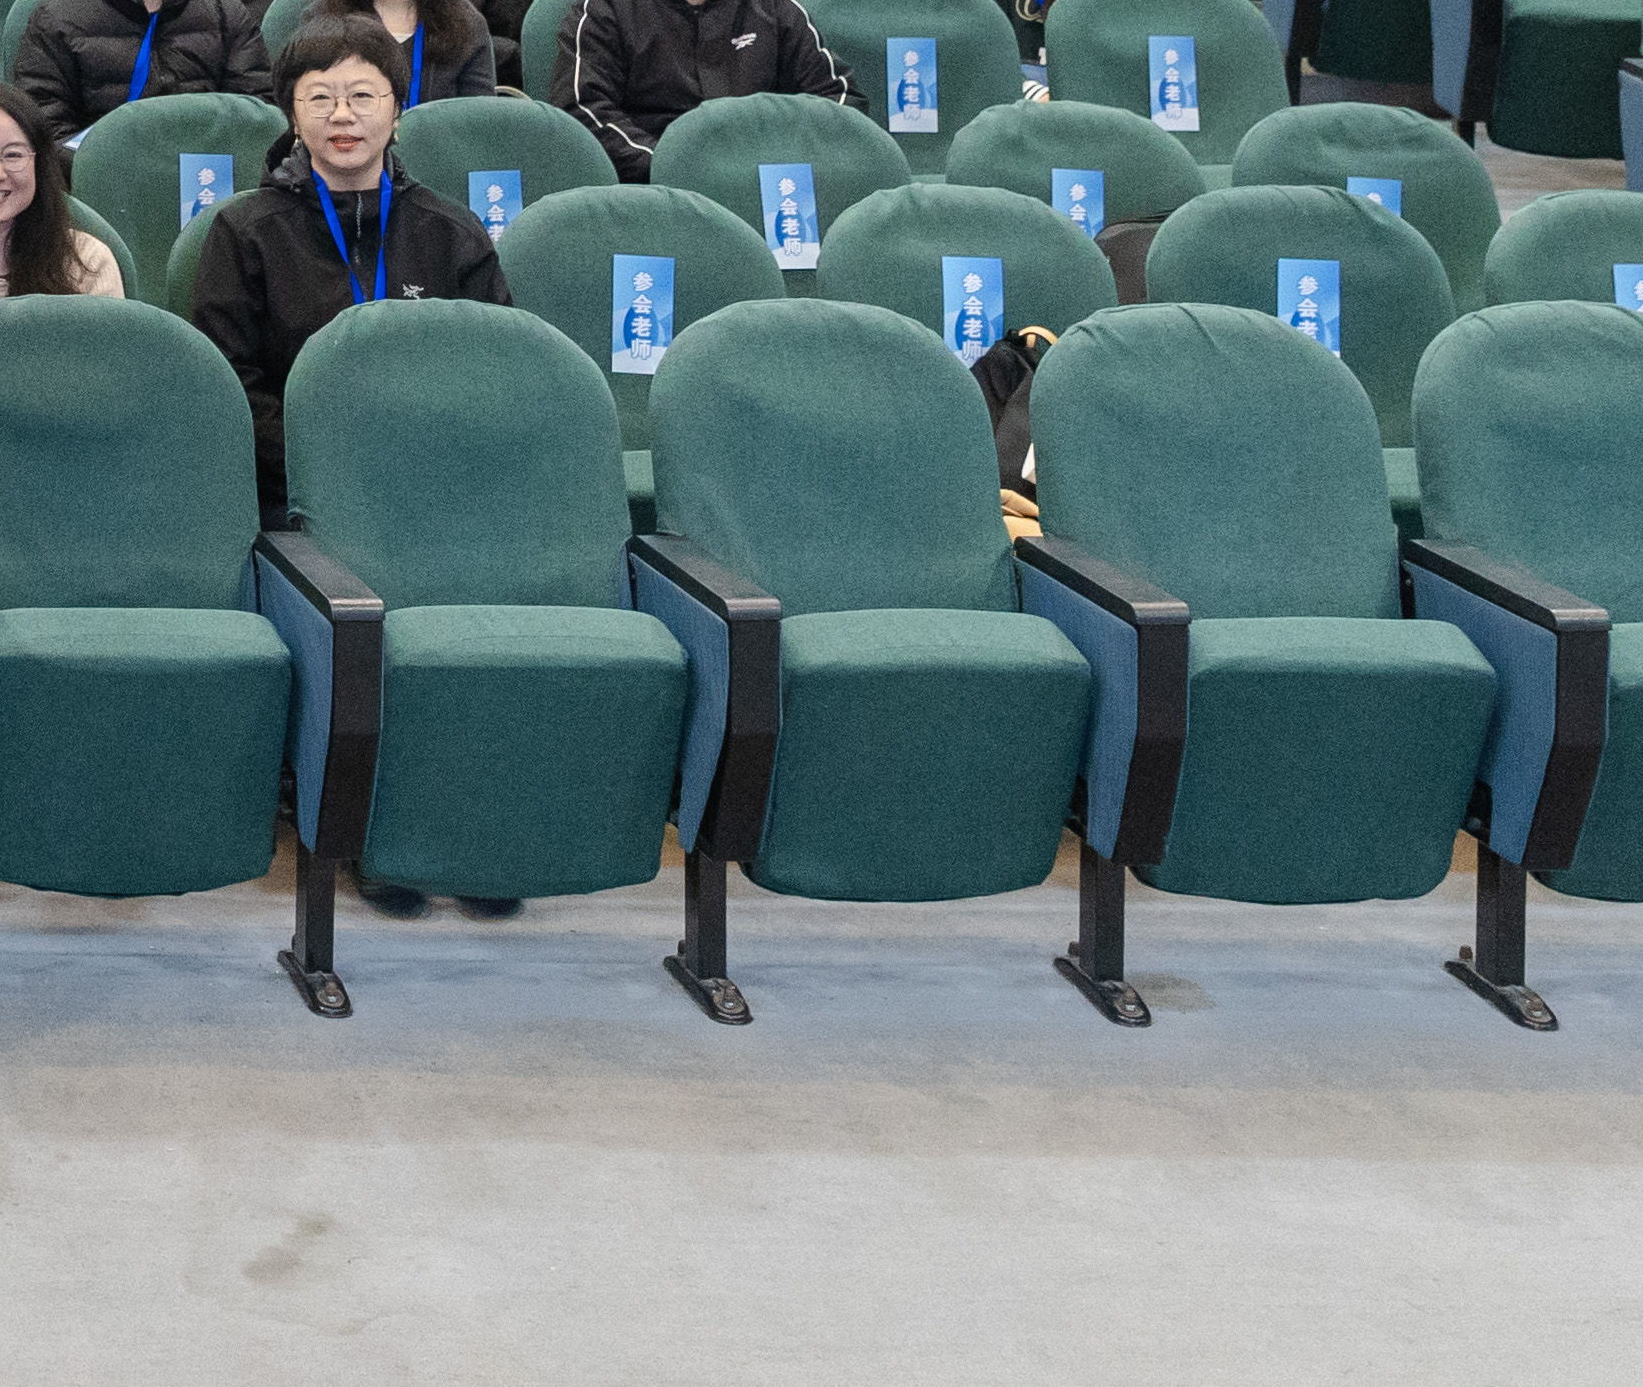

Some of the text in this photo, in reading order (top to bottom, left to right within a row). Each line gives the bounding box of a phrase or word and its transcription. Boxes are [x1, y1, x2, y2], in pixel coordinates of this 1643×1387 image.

[903, 49, 921, 120] 参会老师
[1163, 48, 1182, 120] 参会老师
[777, 177, 802, 256] 参会老师
[630, 271, 654, 361] 参会老师
[962, 272, 983, 361] 参会老师
